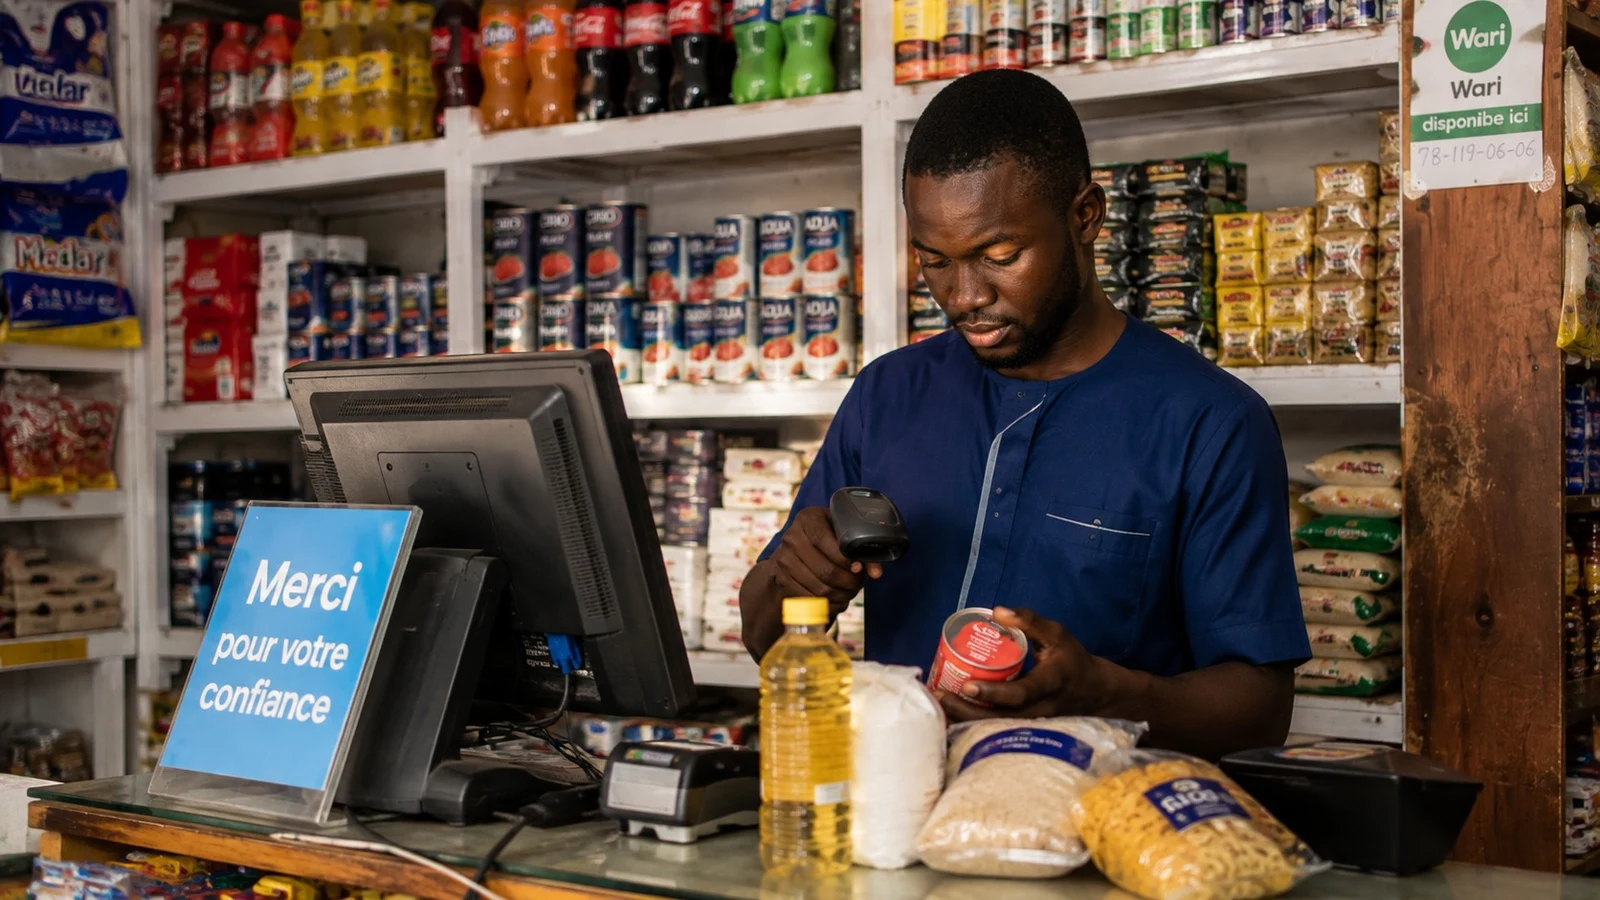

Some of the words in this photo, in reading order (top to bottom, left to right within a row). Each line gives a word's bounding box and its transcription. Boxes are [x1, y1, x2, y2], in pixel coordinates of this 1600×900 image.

[1449, 23, 1506, 50] Wari
[1450, 75, 1502, 99] Wari
[1422, 110, 1504, 134] disponibe
[1509, 106, 1529, 124] ici
[246, 559, 363, 612] Merci
[211, 632, 279, 666] pour
[281, 635, 349, 671] votre
[199, 678, 331, 724] confiance
